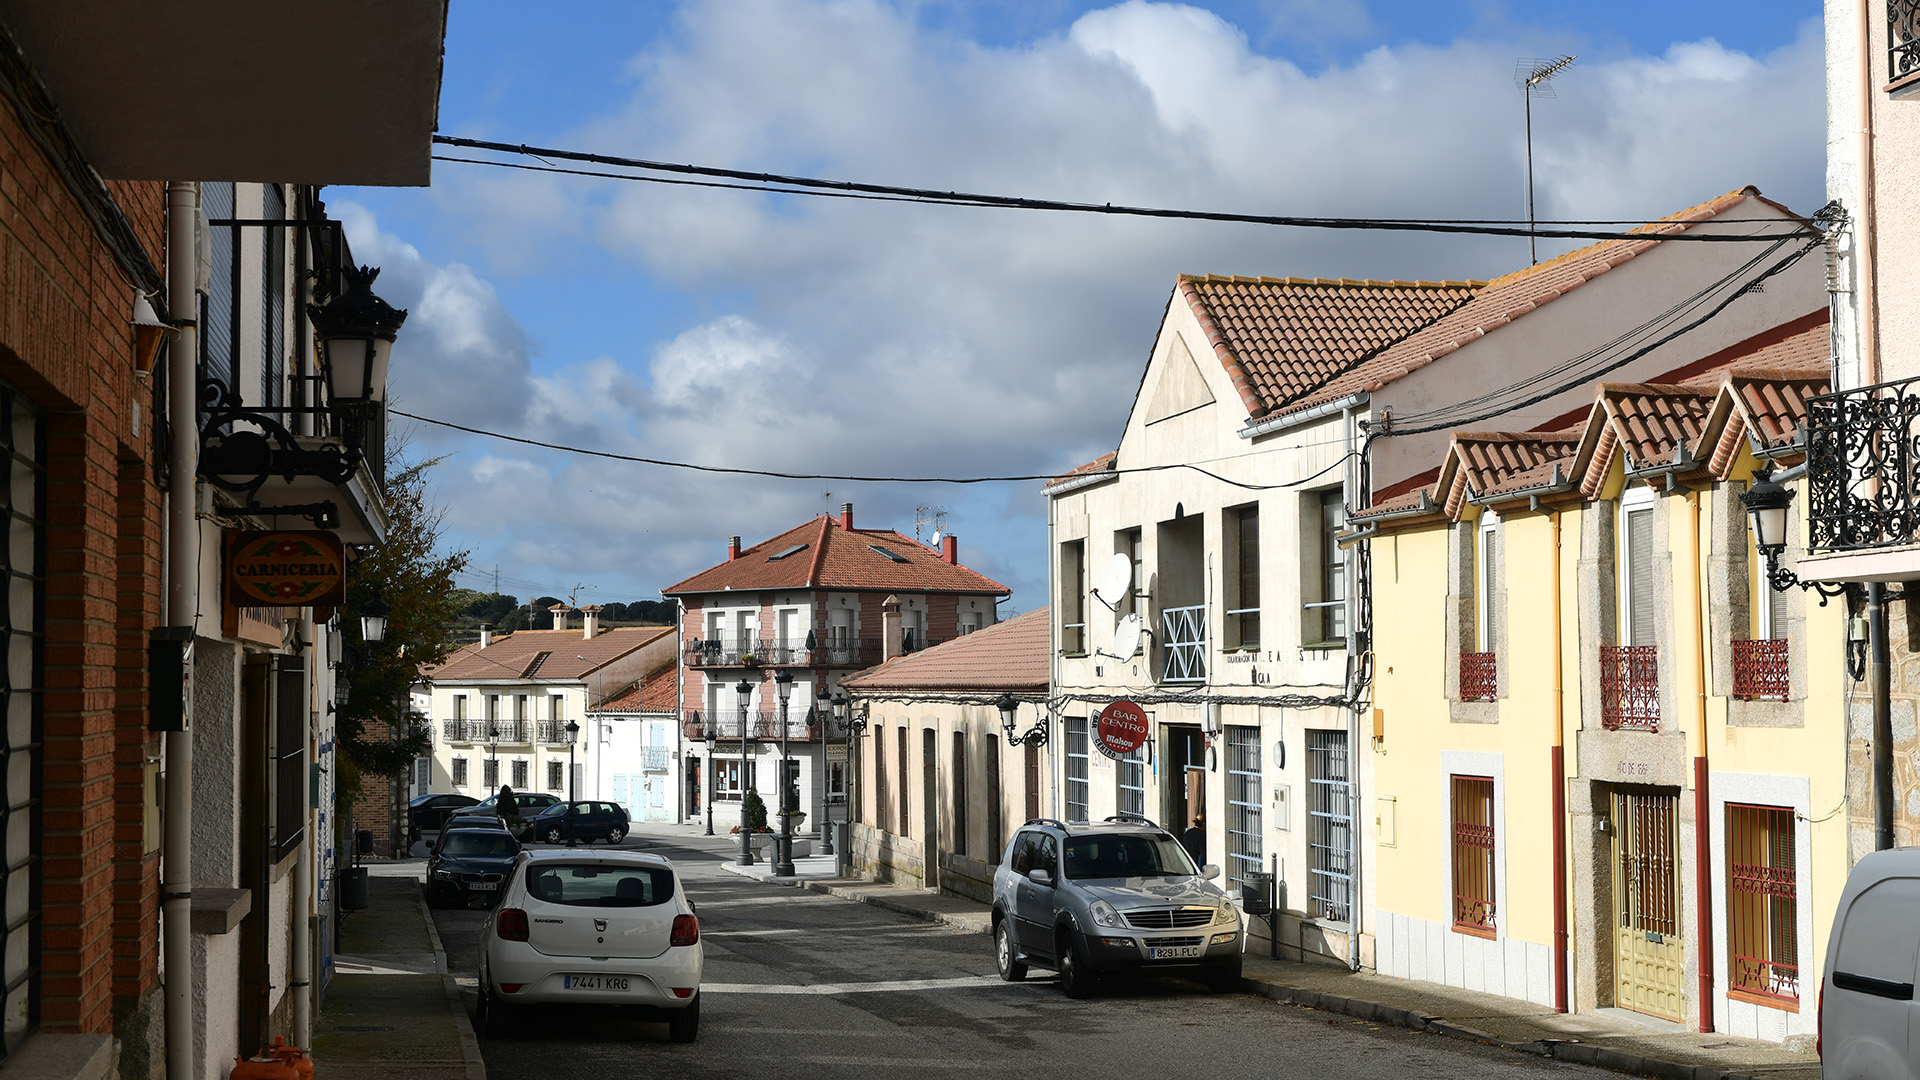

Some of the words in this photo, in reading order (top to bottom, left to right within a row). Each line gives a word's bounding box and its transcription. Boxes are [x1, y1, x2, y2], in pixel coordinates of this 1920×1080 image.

[236, 563, 338, 577] CARNICERIA
[1091, 714, 1099, 729] BAR
[1112, 709, 1138, 722] BAR
[1101, 716, 1146, 734] CENTRO
[1094, 738, 1117, 758] CENTRO
[1106, 734, 1134, 748] Mahou
[1157, 948, 1178, 958] 8291
[1182, 947, 1198, 957] FLC
[572, 976, 601, 989] 7441
[606, 978, 629, 990] KRG
